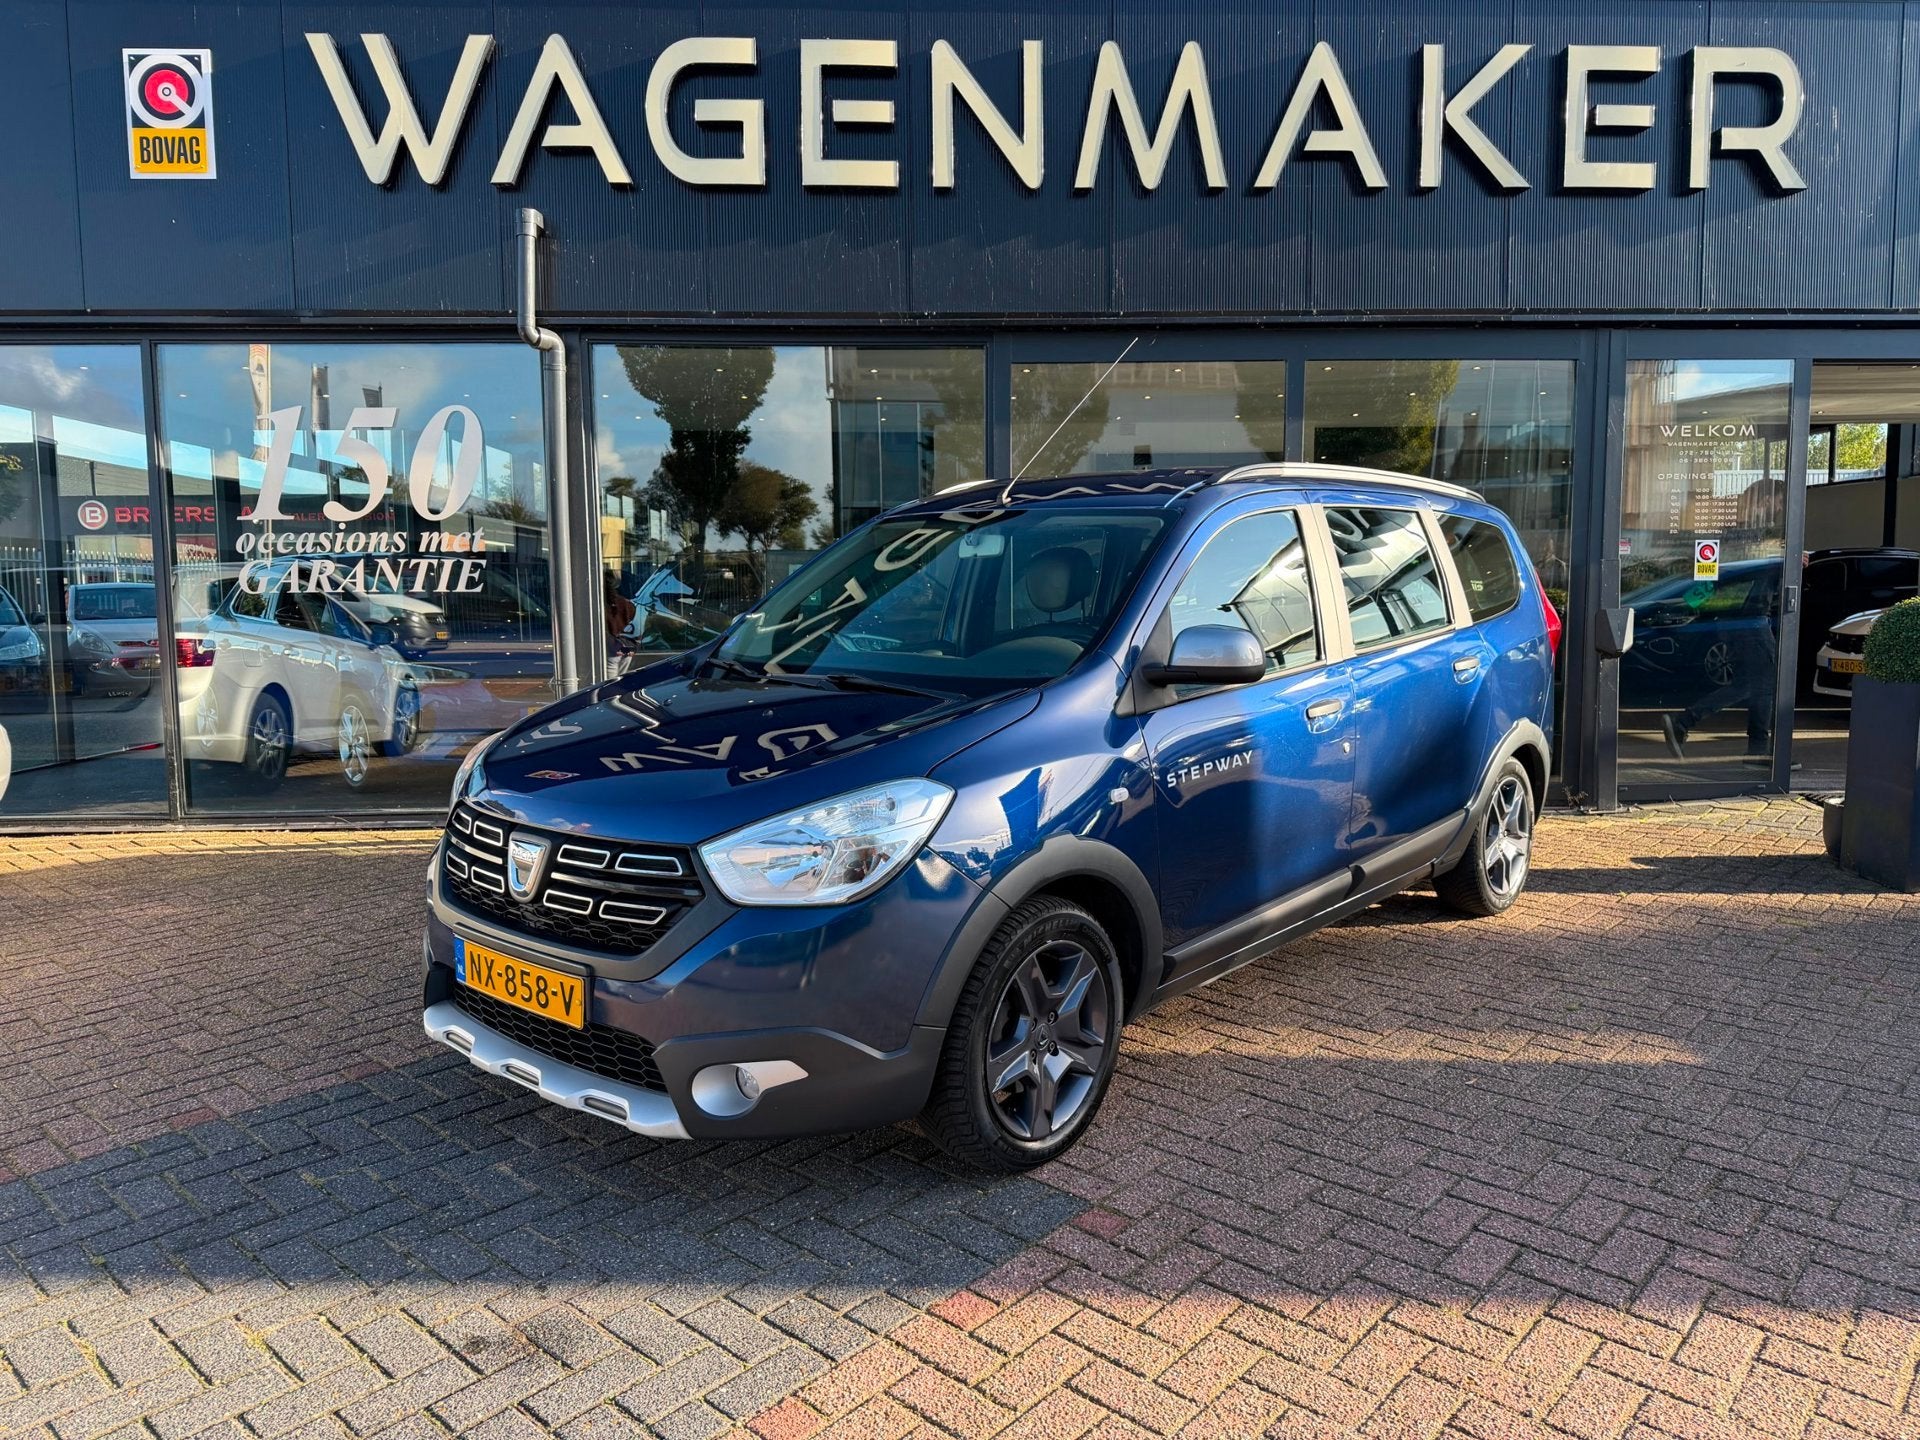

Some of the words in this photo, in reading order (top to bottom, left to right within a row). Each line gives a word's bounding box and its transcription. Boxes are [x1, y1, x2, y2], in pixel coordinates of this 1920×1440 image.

[304, 31, 1809, 190] WAGENMAKER
[139, 136, 201, 165] BOVAG
[1660, 424, 1755, 437] WELKOM
[237, 404, 484, 522] 150
[114, 506, 215, 524] BRERS
[235, 523, 408, 553] occasions
[418, 527, 485, 553] met
[239, 558, 487, 594] GARANTIE
[1697, 564, 1715, 574] BOVAG
[1833, 661, 1863, 672] X-480-S
[1167, 750, 1253, 788] STEPWAY
[469, 949, 575, 1017] NX-858-V
